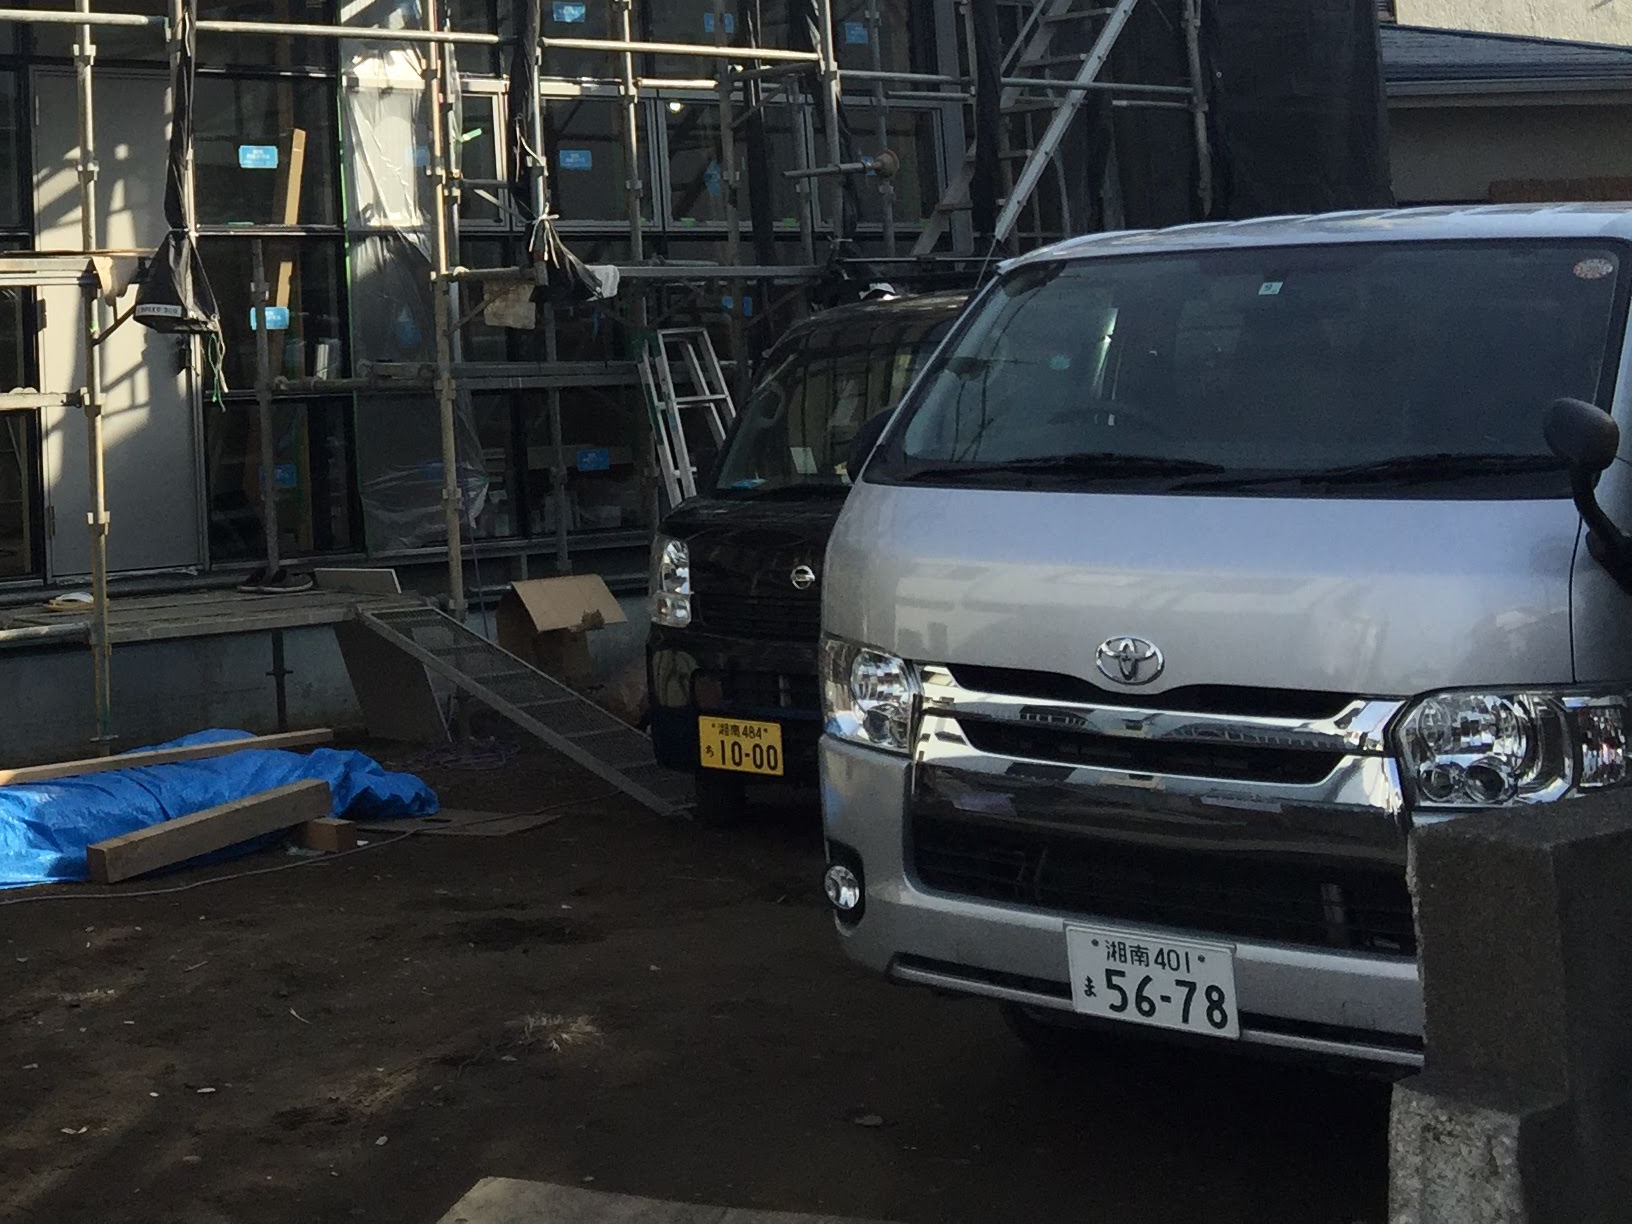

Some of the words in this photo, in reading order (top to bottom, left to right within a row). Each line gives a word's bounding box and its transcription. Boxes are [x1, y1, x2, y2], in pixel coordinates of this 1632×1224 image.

[721, 739, 778, 771] 10-00
[1104, 939, 1190, 974] 湘南401
[1084, 975, 1097, 997] ま
[1104, 967, 1228, 1030] 56-78
